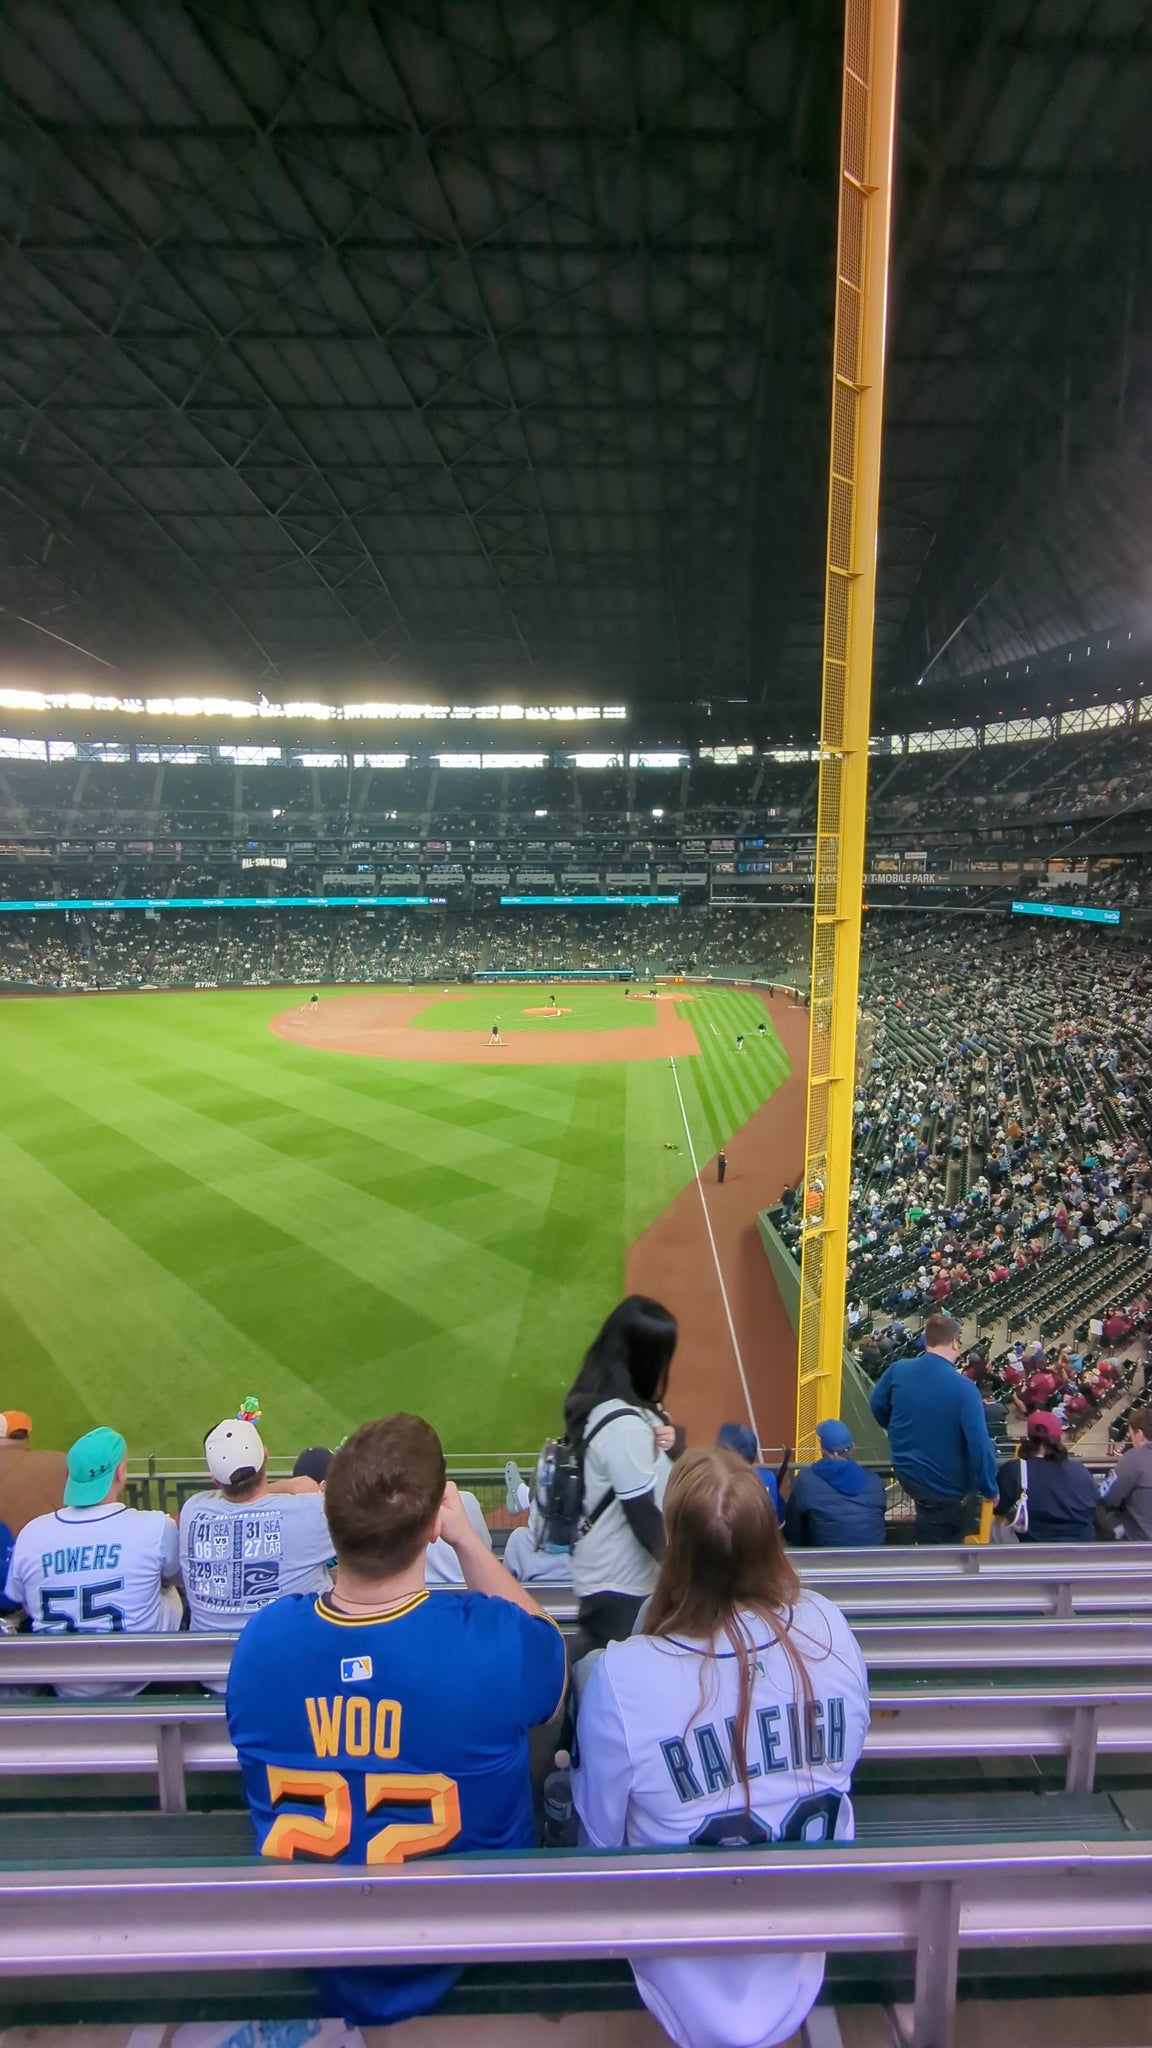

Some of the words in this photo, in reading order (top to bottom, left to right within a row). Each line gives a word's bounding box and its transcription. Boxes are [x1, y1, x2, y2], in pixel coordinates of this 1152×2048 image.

[271, 858, 287, 869] CLUB
[870, 873, 910, 883] T-MOBILE
[912, 873, 935, 883] PARK
[197, 1524, 210, 1542] 41
[214, 1524, 229, 1537] SEA
[246, 1522, 260, 1539] 31
[264, 1520, 280, 1533] SEA
[196, 1542, 212, 1558] 06
[216, 1546, 226, 1558] SF
[244, 1539, 262, 1557] 27
[264, 1542, 280, 1554] LAR
[41, 1543, 122, 1578] POWERS
[197, 1562, 212, 1579] 29
[213, 1564, 228, 1576] SEA
[39, 1576, 124, 1632] 55
[305, 1696, 402, 1759] WOO
[659, 1697, 846, 1803] RALEIGH
[261, 1764, 462, 1864] 22
